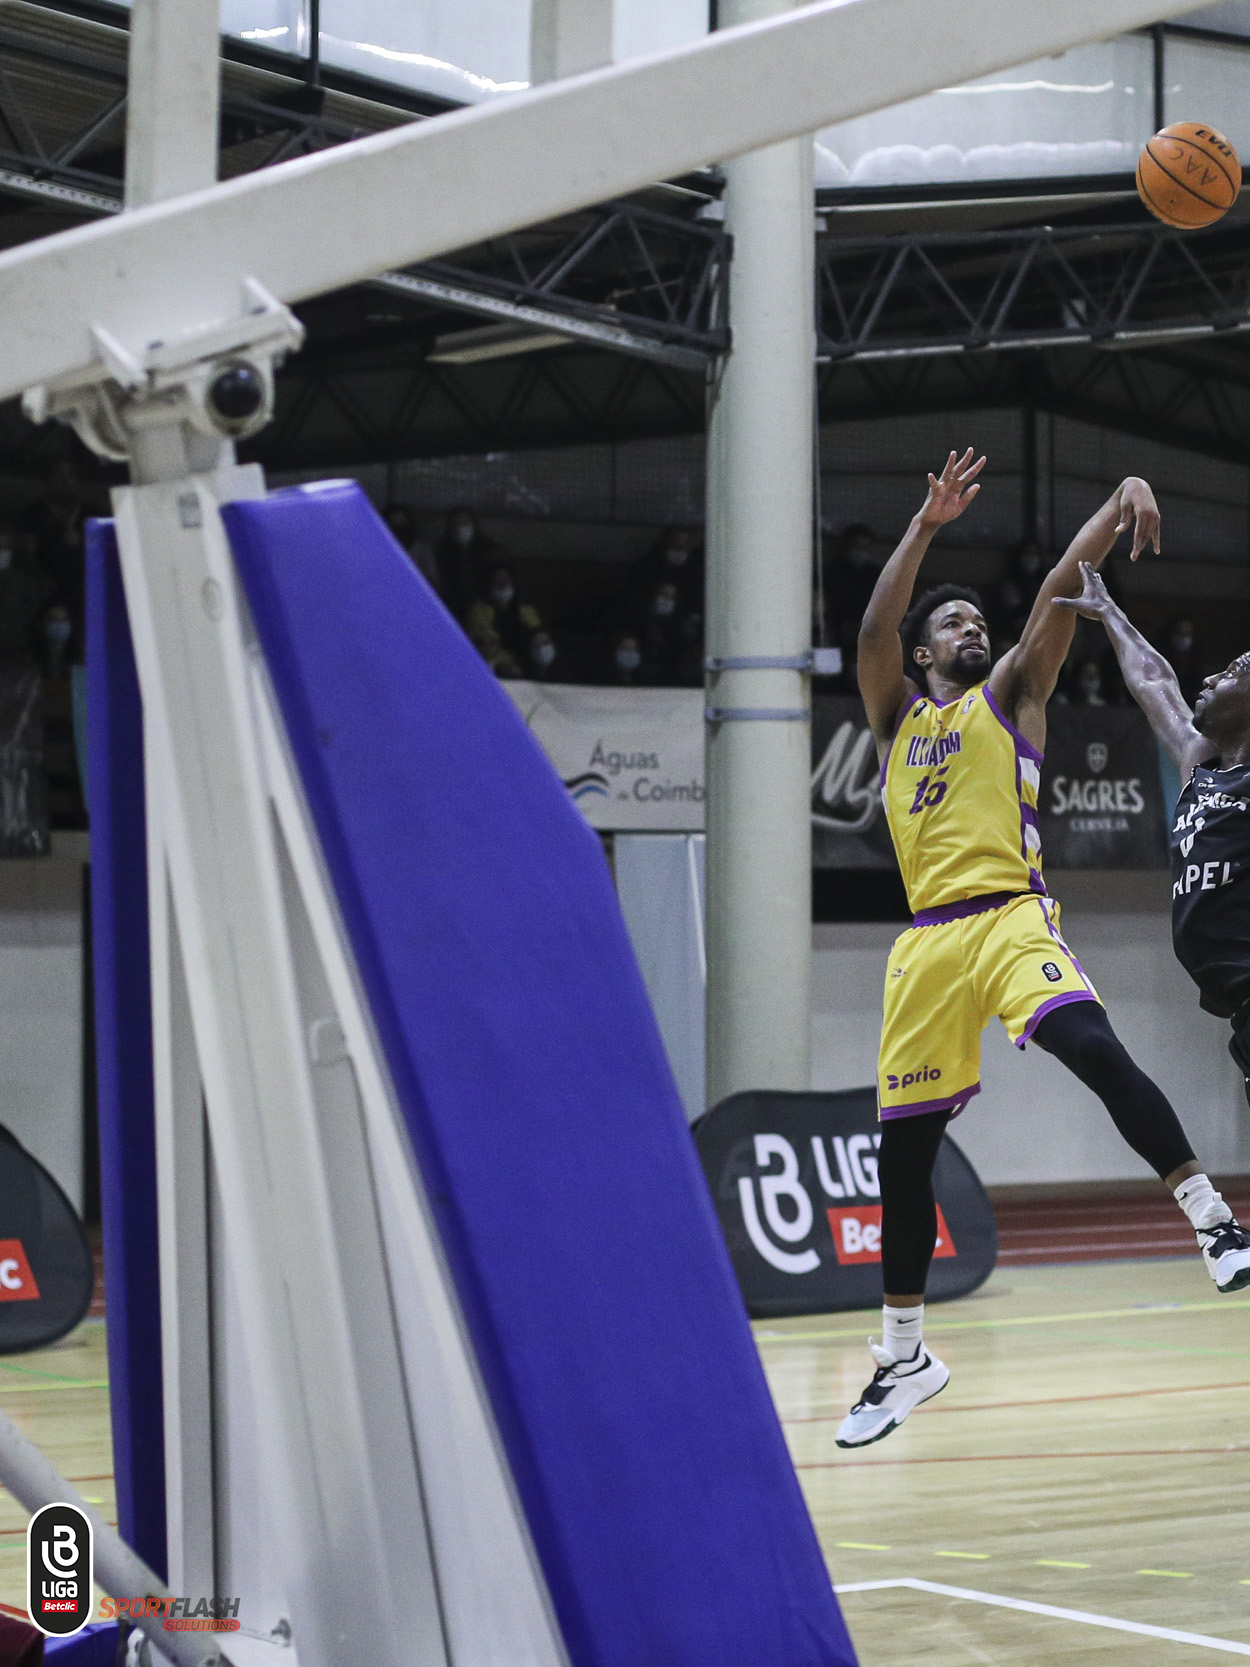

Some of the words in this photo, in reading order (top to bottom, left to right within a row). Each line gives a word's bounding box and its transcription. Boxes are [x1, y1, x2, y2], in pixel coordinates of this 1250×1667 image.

[589, 738, 660, 775] Águas
[633, 777, 706, 801] Coimb
[909, 765, 950, 815] 15
[1051, 774, 1145, 815] SAGRES
[1172, 861, 1234, 900] APEL
[901, 1065, 942, 1089] prio
[811, 1133, 884, 1198] LIG
